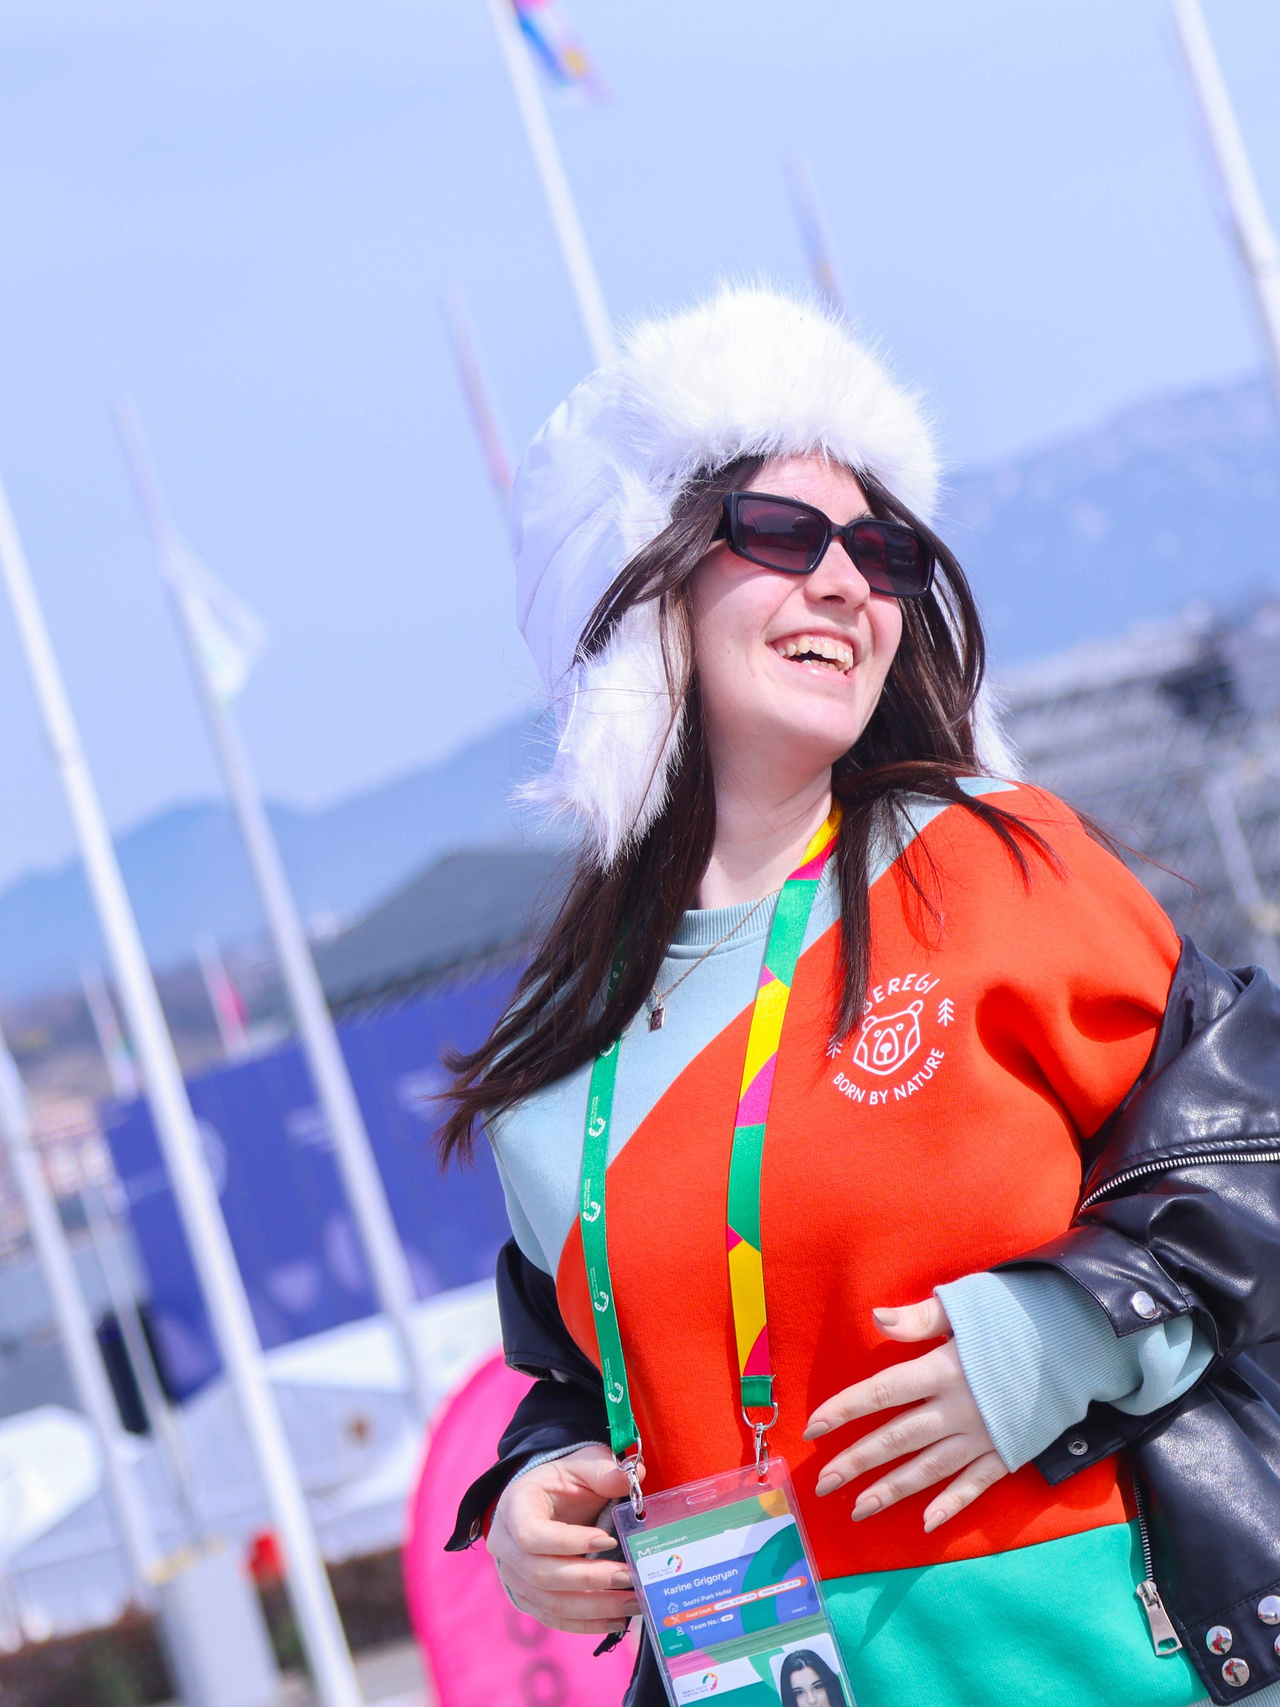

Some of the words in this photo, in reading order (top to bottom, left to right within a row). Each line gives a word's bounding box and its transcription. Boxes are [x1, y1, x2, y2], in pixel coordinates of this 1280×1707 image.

[833, 1072, 866, 1103] BORN
[869, 1089, 889, 1105] BY
[893, 1048, 945, 1101] NATURE
[663, 1582, 692, 1597] Karine
[694, 1568, 738, 1587] Grigoryan
[683, 1597, 700, 1607] Sochi
[701, 1593, 715, 1602] Park
[715, 1588, 732, 1597] Hotel
[690, 1622, 706, 1631] Team
